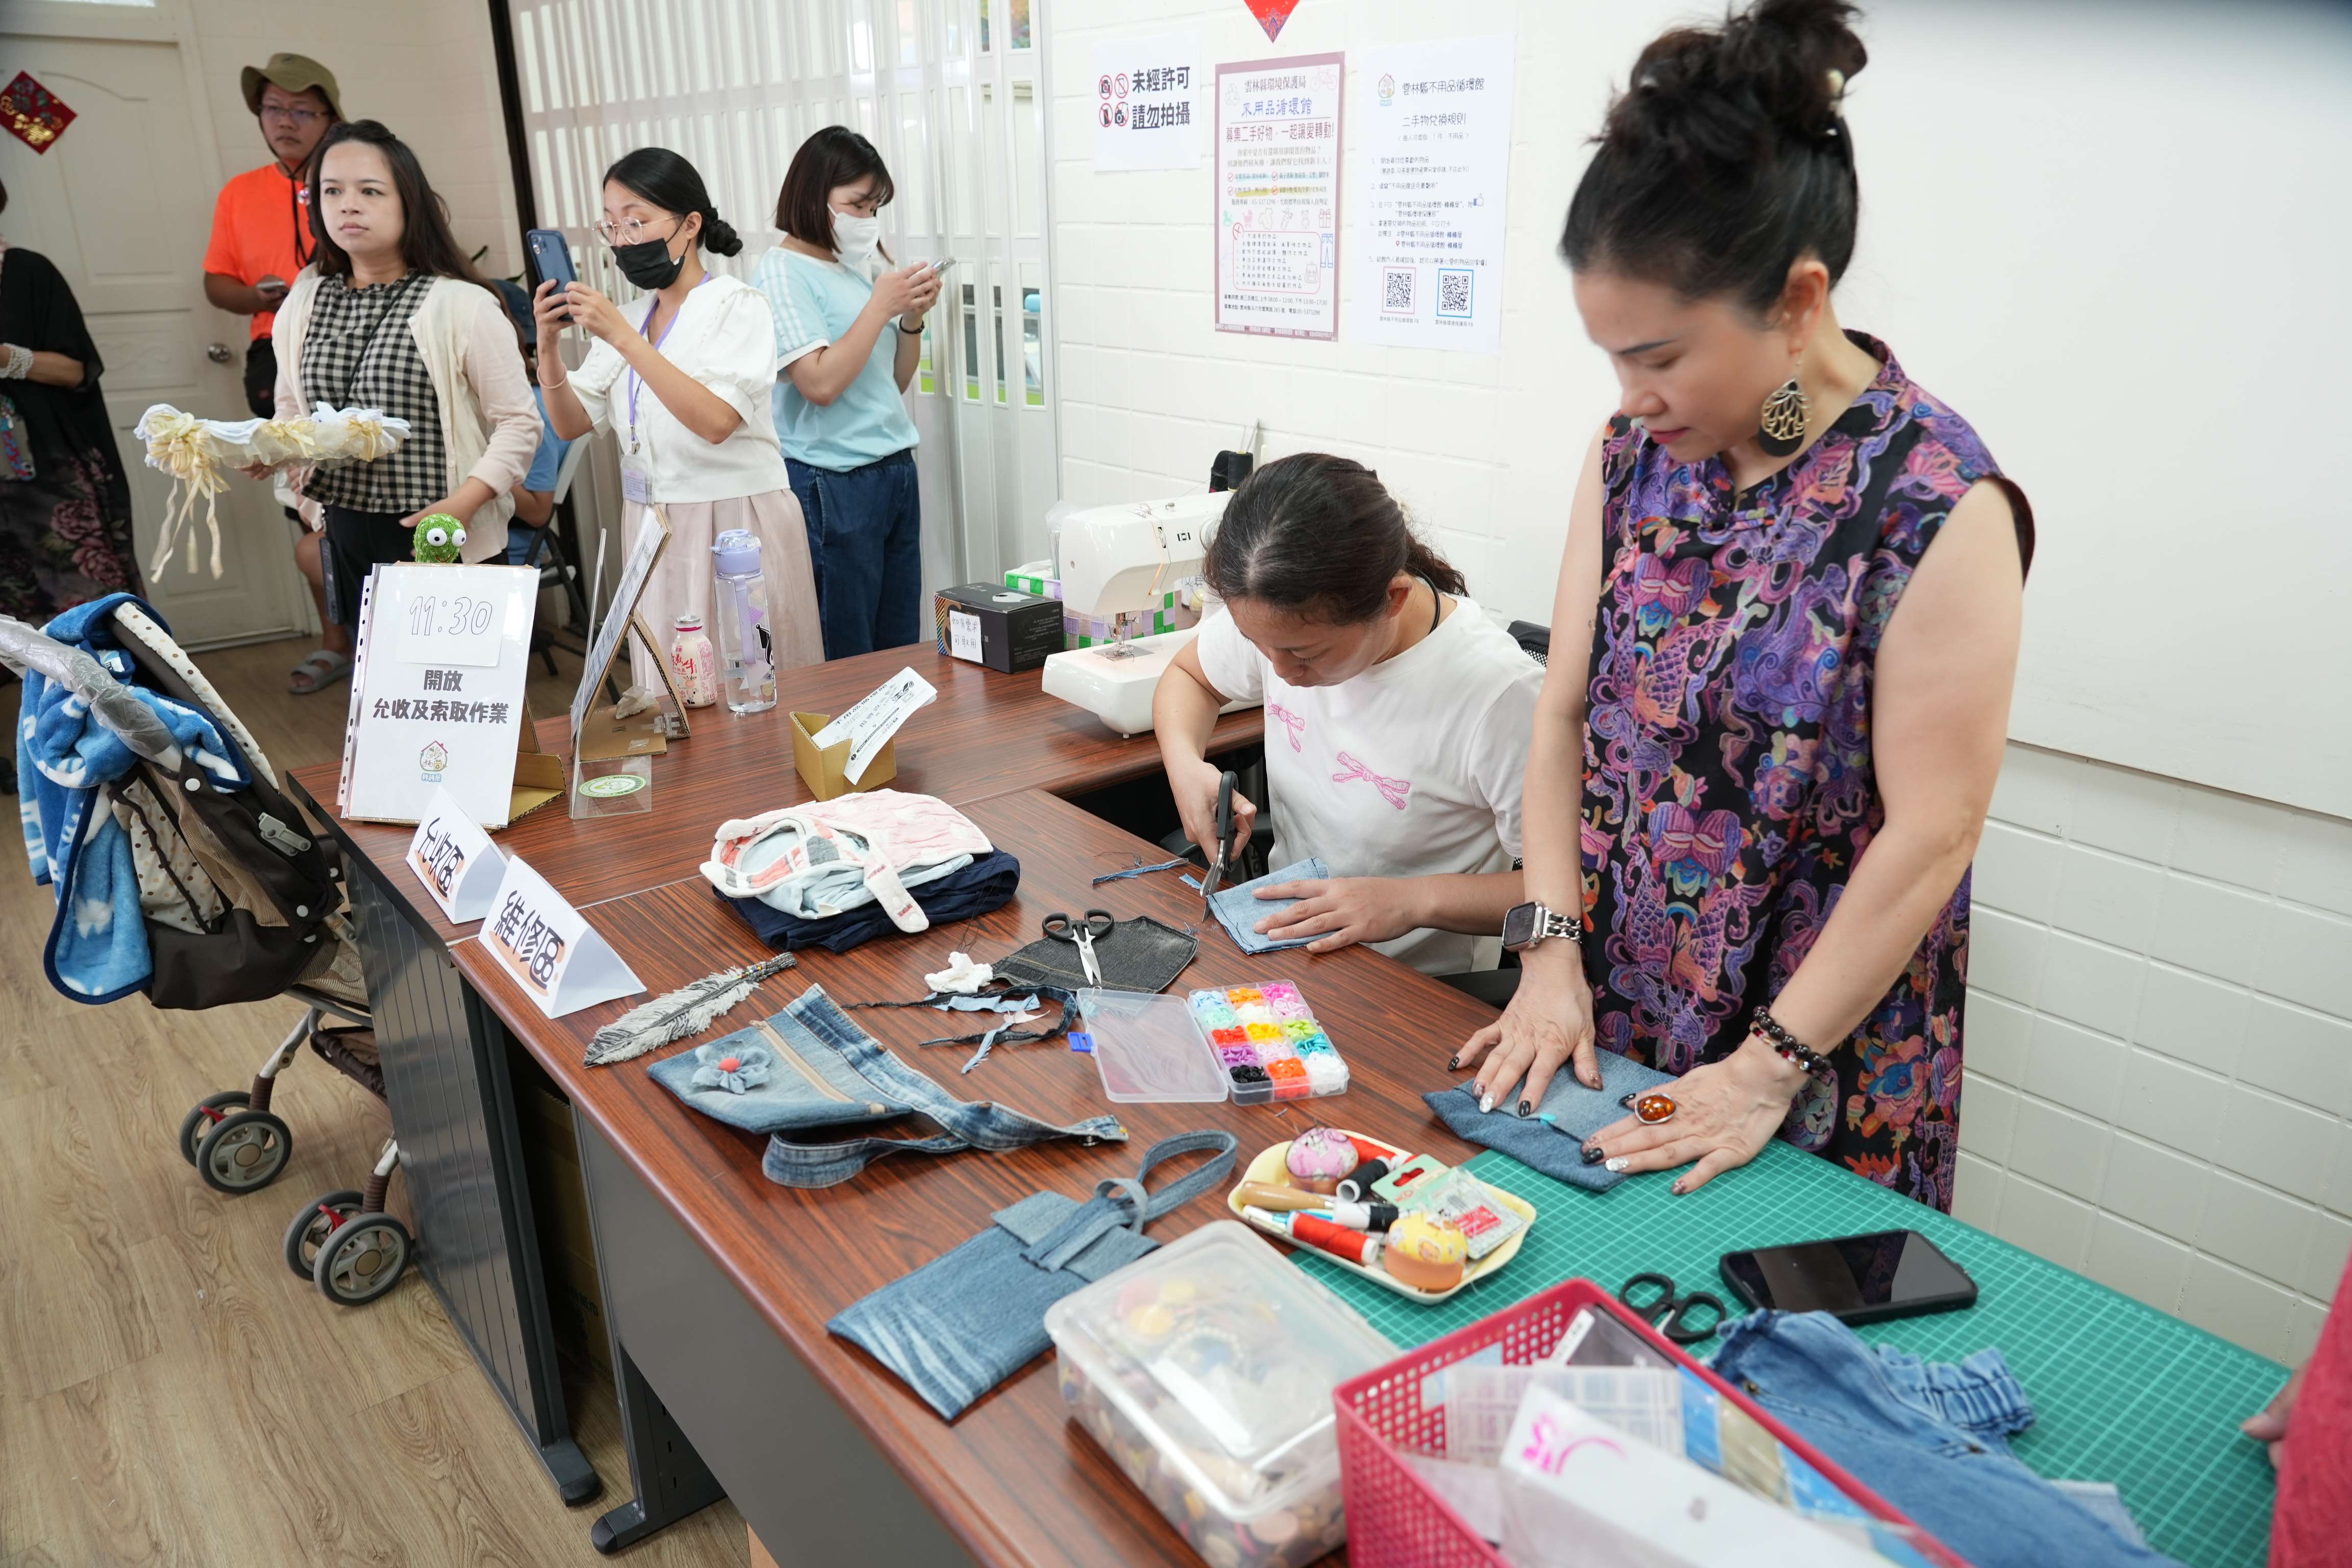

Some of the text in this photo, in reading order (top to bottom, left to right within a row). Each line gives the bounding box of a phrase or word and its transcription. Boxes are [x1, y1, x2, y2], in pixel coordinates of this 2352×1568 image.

[1132, 66, 1190, 93] 未經許可
[1245, 76, 1306, 93] 雲林縣環境保護局
[1402, 78, 1485, 95] 雲林縣不用品循環館
[1132, 102, 1190, 128] 請勿拍攝
[1241, 97, 1312, 118] 不用品循環館
[1402, 112, 1466, 128] 二手物兌換規則
[409, 596, 493, 635] 11:30
[952, 616, 977, 633] 如有需求
[954, 635, 976, 649] 可取用
[424, 670, 463, 692] 開放
[373, 698, 509, 724] 允收及索取作業
[418, 817, 464, 898] 允收區
[494, 890, 565, 989] 維修區
